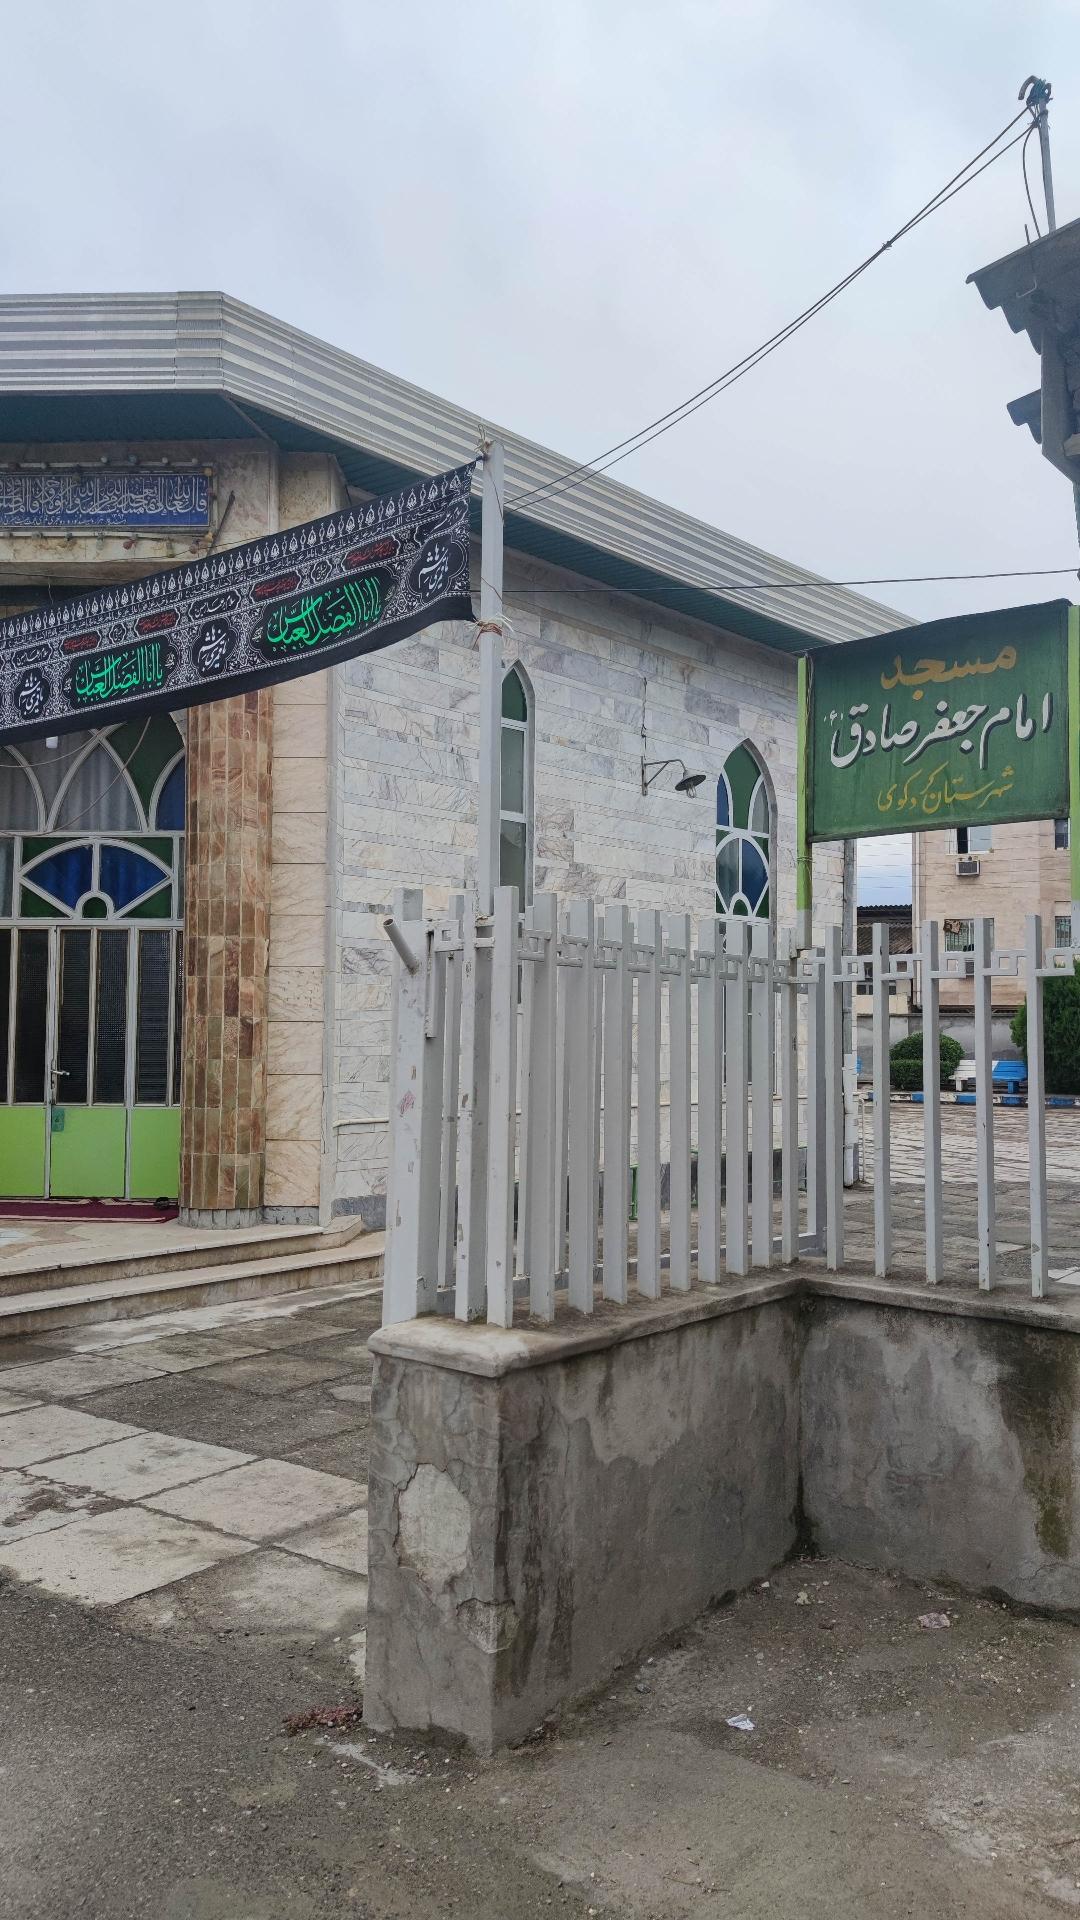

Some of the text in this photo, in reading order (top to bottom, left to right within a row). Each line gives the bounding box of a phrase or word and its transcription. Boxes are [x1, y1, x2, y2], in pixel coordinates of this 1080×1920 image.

[880, 645, 1017, 700] مسجد
[830, 703, 920, 769] صادق
[902, 700, 988, 764] جعفر
[979, 692, 1052, 770] امام
[922, 765, 1015, 815] شهرستان
